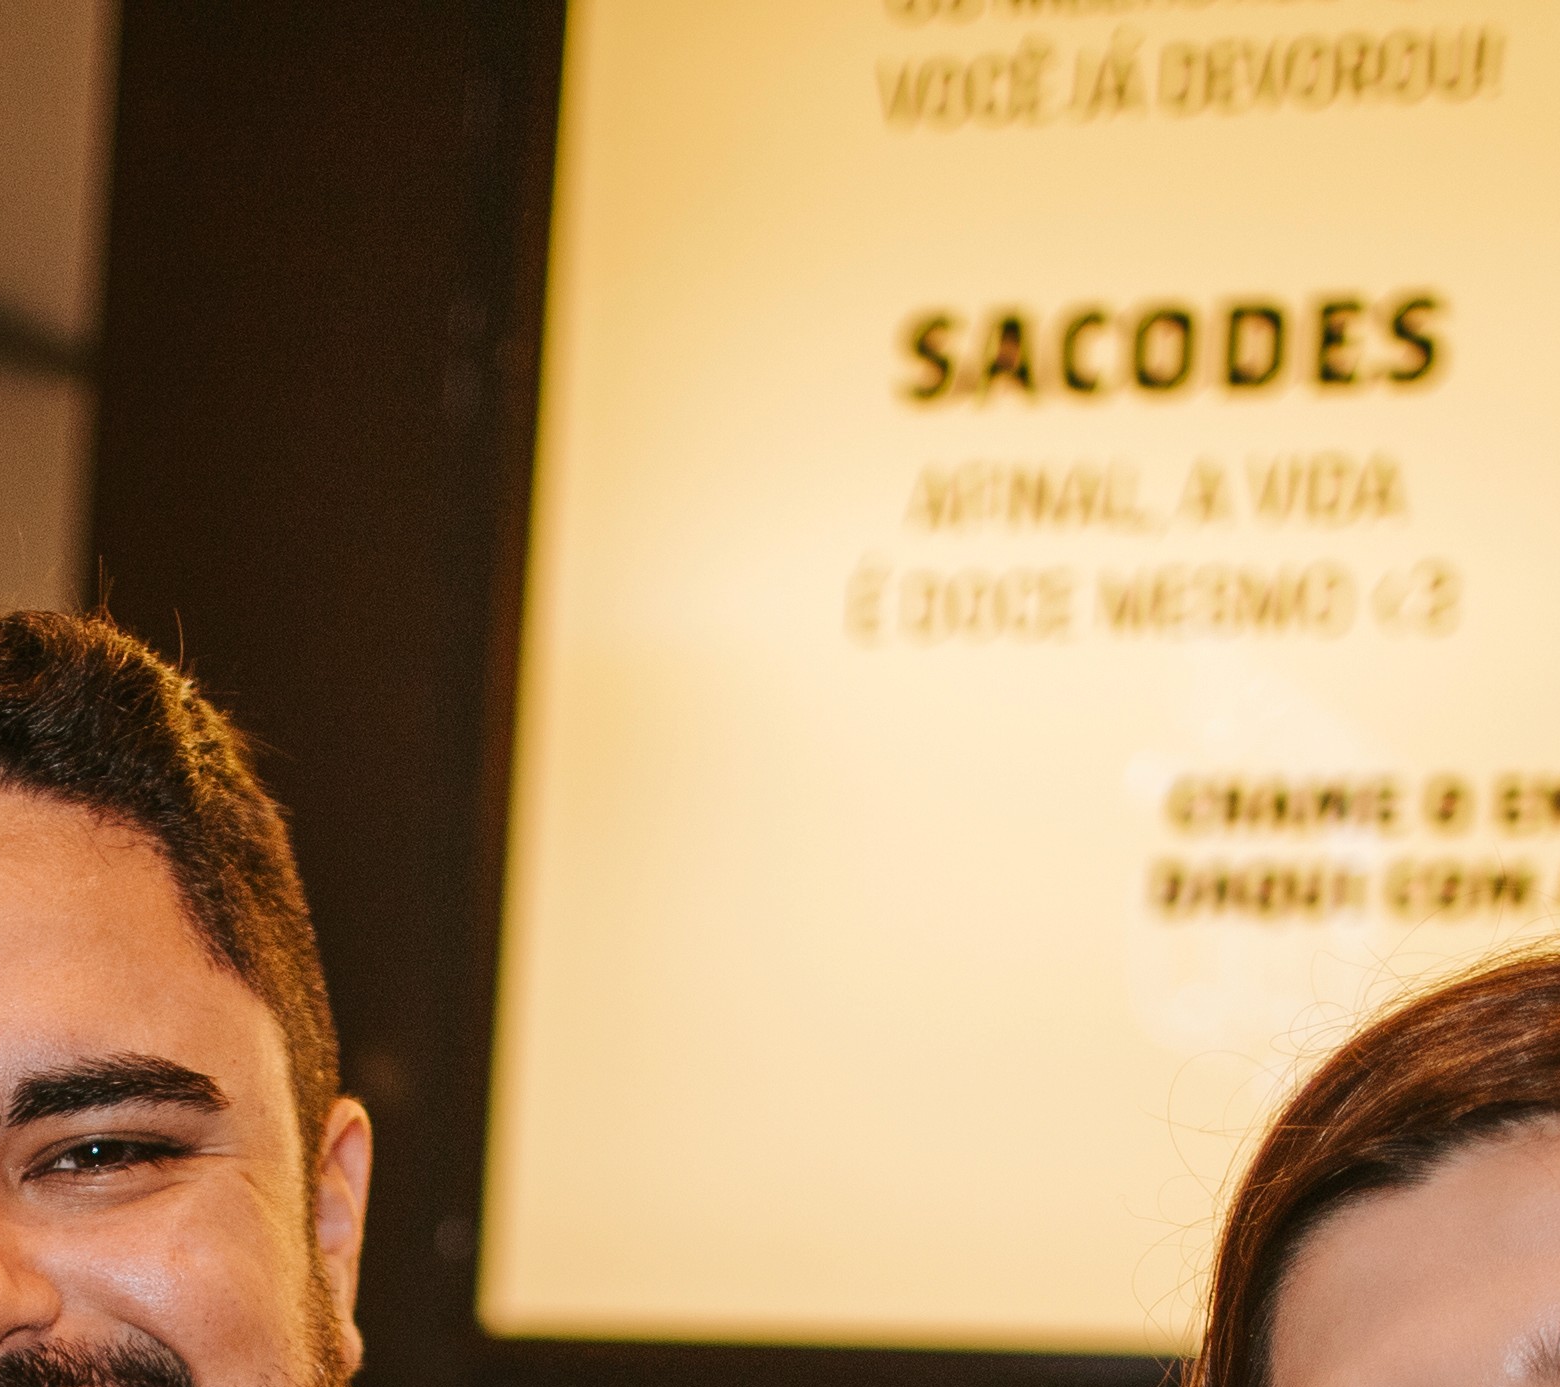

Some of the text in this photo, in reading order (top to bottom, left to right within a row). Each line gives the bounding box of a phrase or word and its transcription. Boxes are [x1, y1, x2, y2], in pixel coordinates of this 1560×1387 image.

[900, 290, 1448, 404] SACODES
[1421, 774, 1472, 836] O
[1383, 860, 1540, 922] COM
